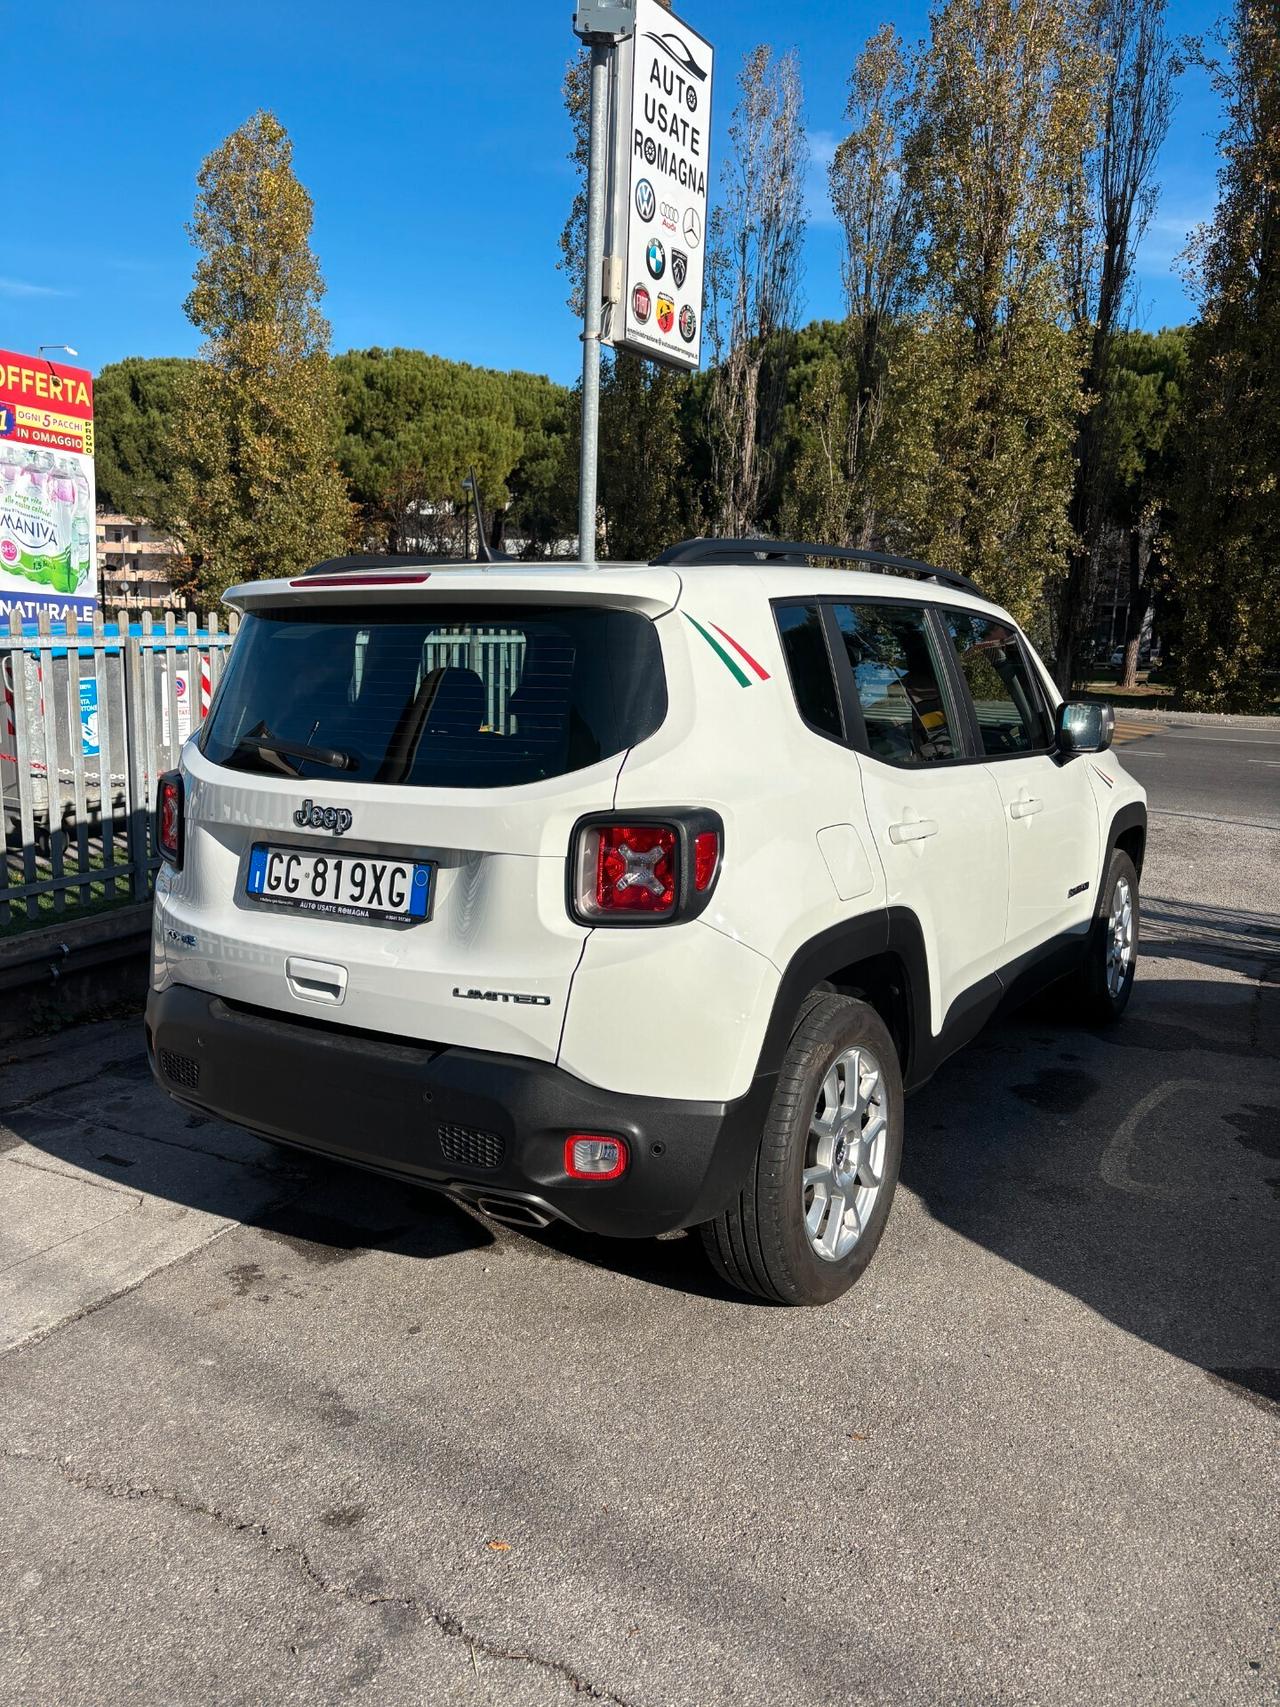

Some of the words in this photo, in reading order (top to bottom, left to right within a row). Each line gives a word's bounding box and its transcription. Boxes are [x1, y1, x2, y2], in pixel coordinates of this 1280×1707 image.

[649, 58, 697, 112] AUTO
[645, 93, 700, 156] USATE
[634, 128, 705, 198] ROMAGNA
[17, 427, 29, 439] IN
[32, 431, 83, 449] OMAGGIO
[18, 411, 41, 422] OGNI
[42, 414, 51, 428] 5
[52, 418, 83, 432] PACCHI
[85, 421, 93, 454] PROMO
[0, 513, 58, 546] MANIVA
[0, 600, 93, 622] NATURALE
[293, 799, 352, 836] Jeep
[310, 859, 408, 908] 819XG
[300, 901, 316, 910] AUTO
[317, 903, 337, 914] USATE
[338, 906, 370, 918] ROMAGNA
[452, 987, 551, 1006] LIMITED
